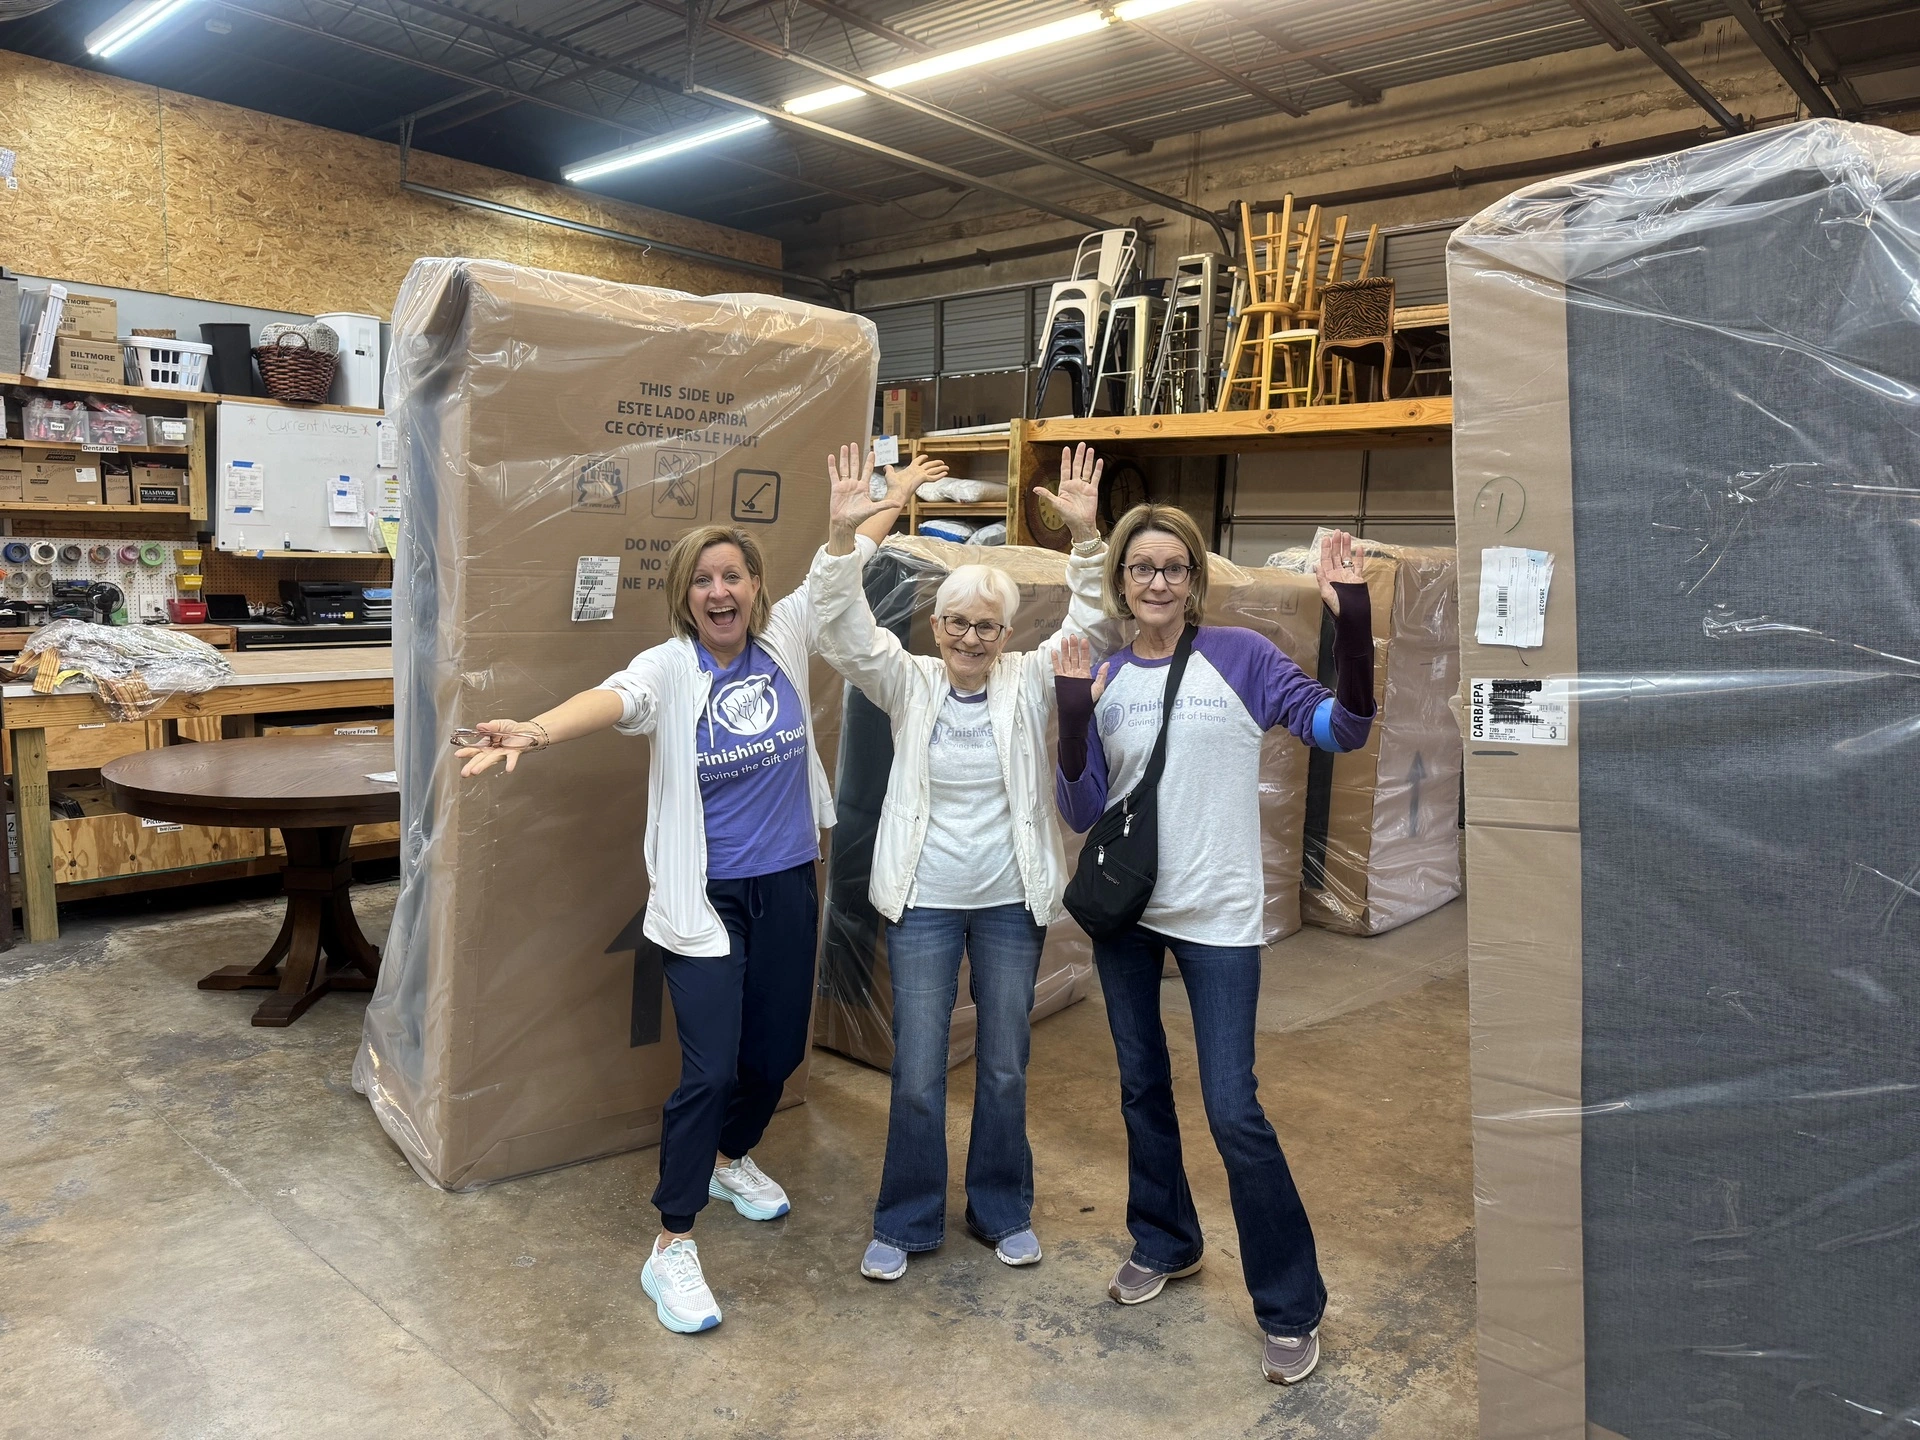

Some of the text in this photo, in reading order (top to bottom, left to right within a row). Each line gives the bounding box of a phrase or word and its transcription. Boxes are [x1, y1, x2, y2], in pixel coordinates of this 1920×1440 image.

[70, 350, 116, 362] BILTMORE
[640, 382, 735, 405] THIS SIDE UP
[617, 400, 748, 427] ESTE LADO ARRIBA
[266, 411, 358, 434] Current Needs
[604, 420, 760, 448] CE CÔTÉ VERS LE HAUT
[587, 460, 615, 473] TEAM
[625, 538, 647, 551] DO
[640, 558, 662, 571] NO
[622, 577, 666, 590] NE PA
[1034, 618, 1060, 628] DO NOT
[1129, 695, 1228, 714] Finishg Touch
[1473, 683, 1484, 738] CARB/EPA
[1127, 718, 1156, 728] Giving
[1170, 712, 1185, 721] Gift
[1187, 712, 1197, 720] of
[1199, 712, 1227, 723] Home
[1549, 726, 1557, 739] 3
[696, 738, 776, 767] Finishing
[700, 769, 739, 782] Giving
[741, 763, 759, 773] the
[761, 753, 781, 767] Gift
[783, 748, 793, 760] of
